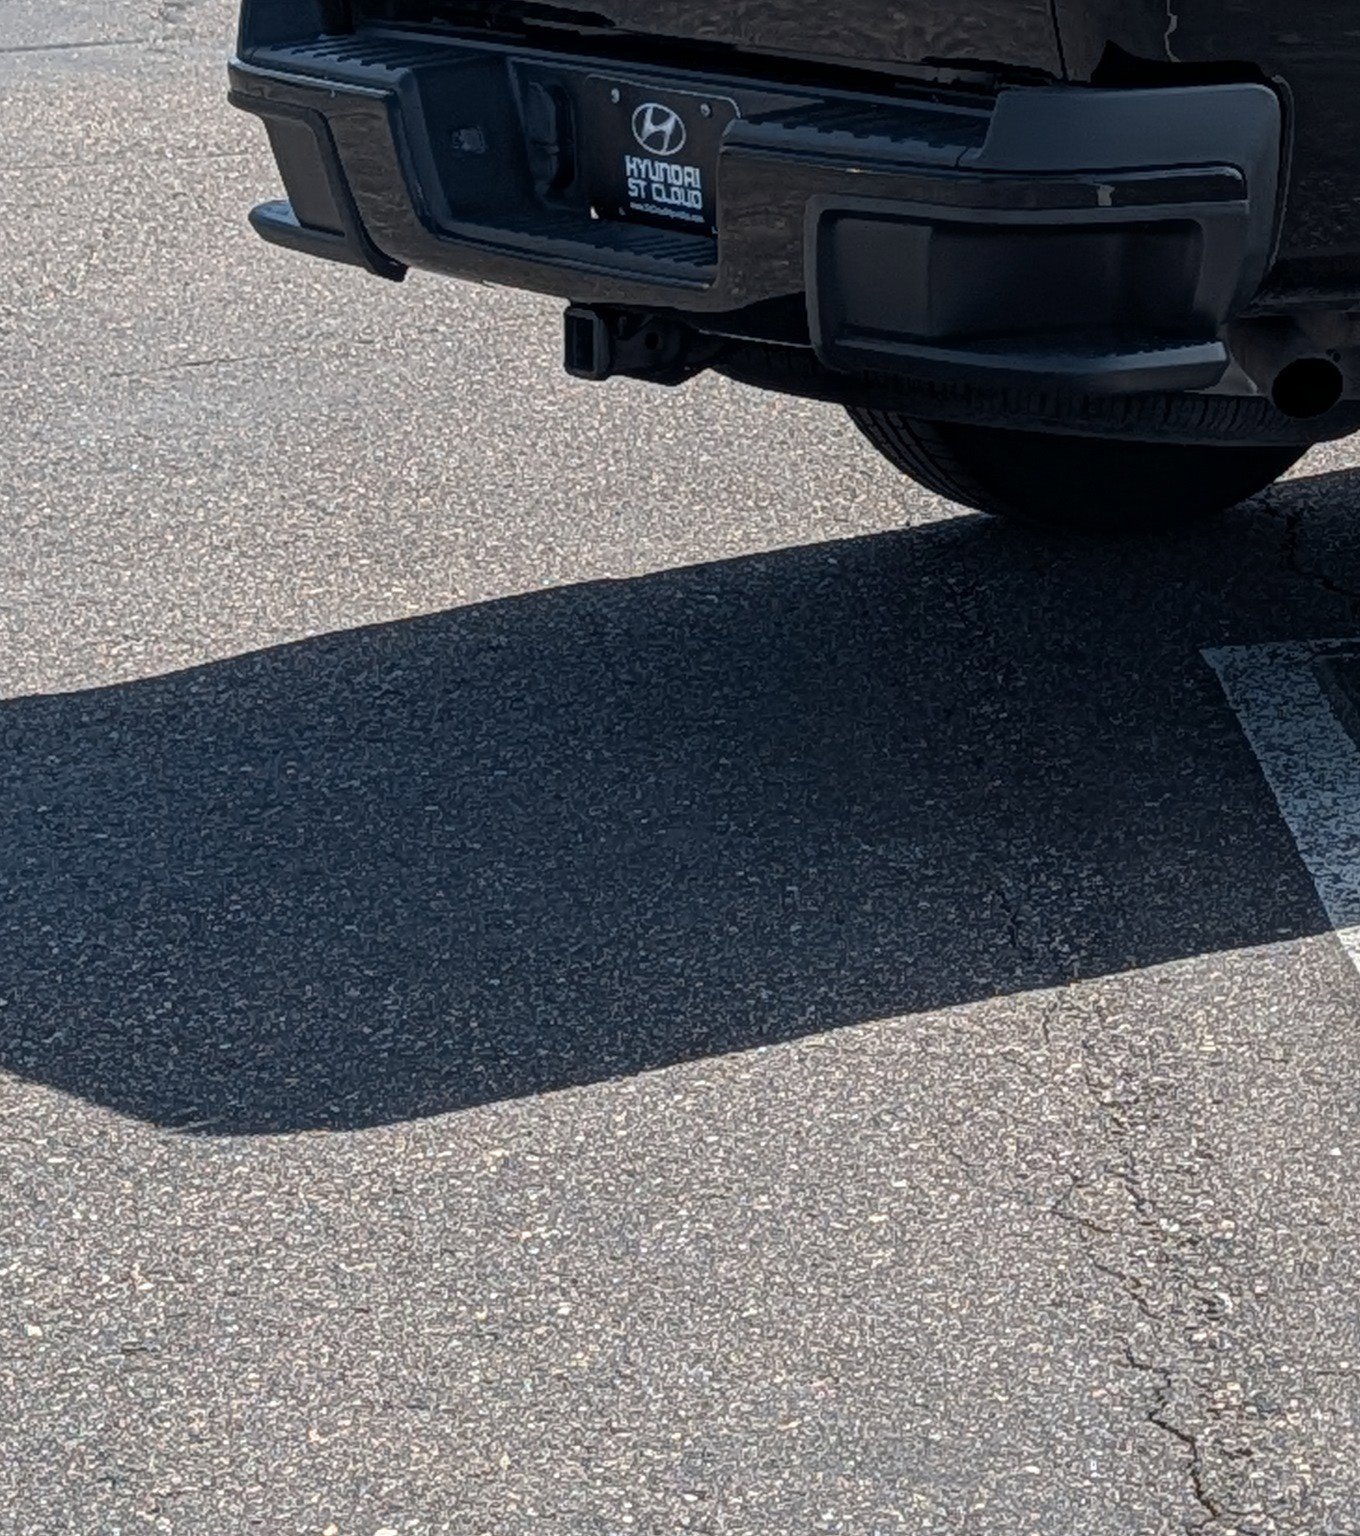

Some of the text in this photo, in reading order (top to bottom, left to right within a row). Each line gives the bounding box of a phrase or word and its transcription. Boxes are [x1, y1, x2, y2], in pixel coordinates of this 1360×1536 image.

[625, 155, 702, 189] HYUNDAI
[628, 177, 703, 209] ST CLOUD
